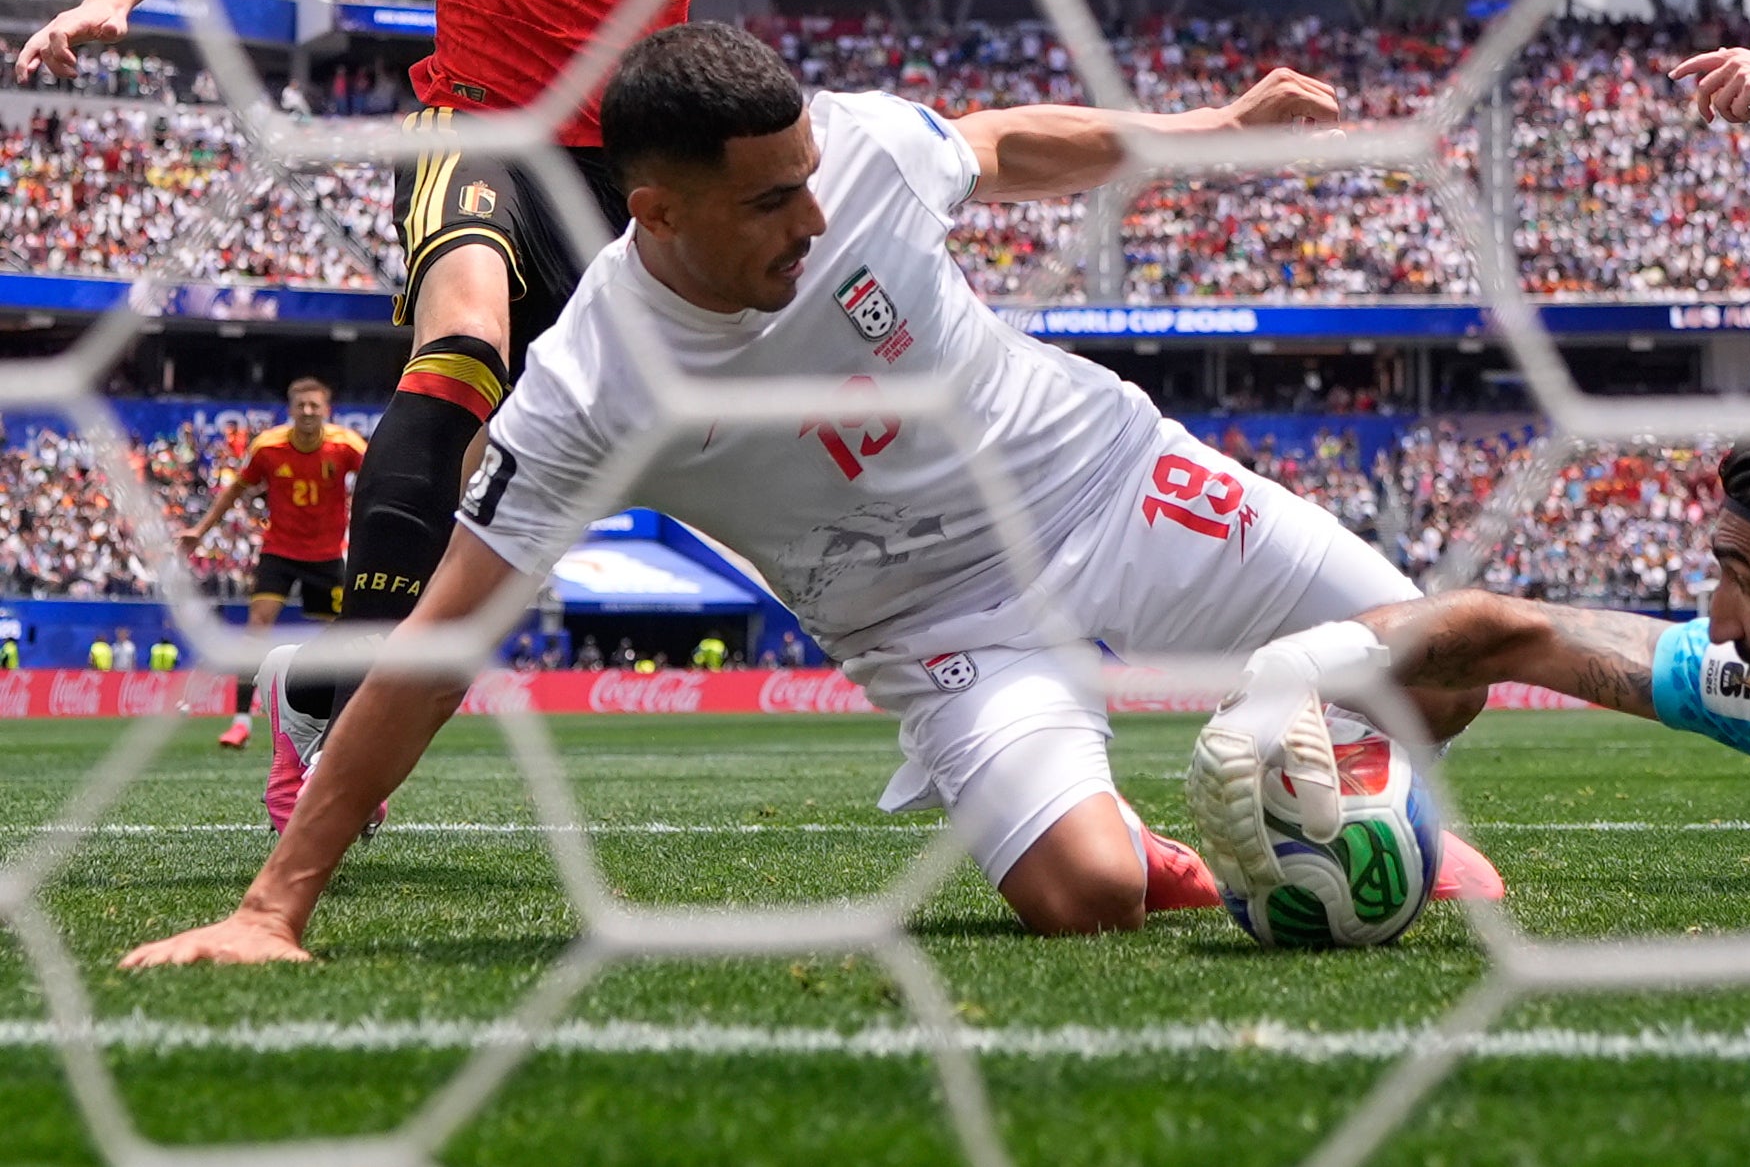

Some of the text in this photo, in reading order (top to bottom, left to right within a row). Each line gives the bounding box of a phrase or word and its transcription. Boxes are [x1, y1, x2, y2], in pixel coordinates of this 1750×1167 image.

[1046, 309, 1128, 333] WORLD
[1128, 309, 1175, 333] CUP
[1175, 309, 1258, 332] 2026
[1669, 304, 1721, 329] LOS
[292, 479, 319, 507] 21
[1142, 454, 1245, 541] 19
[354, 572, 420, 596] RBFA
[589, 668, 708, 714] Coca-Cola
